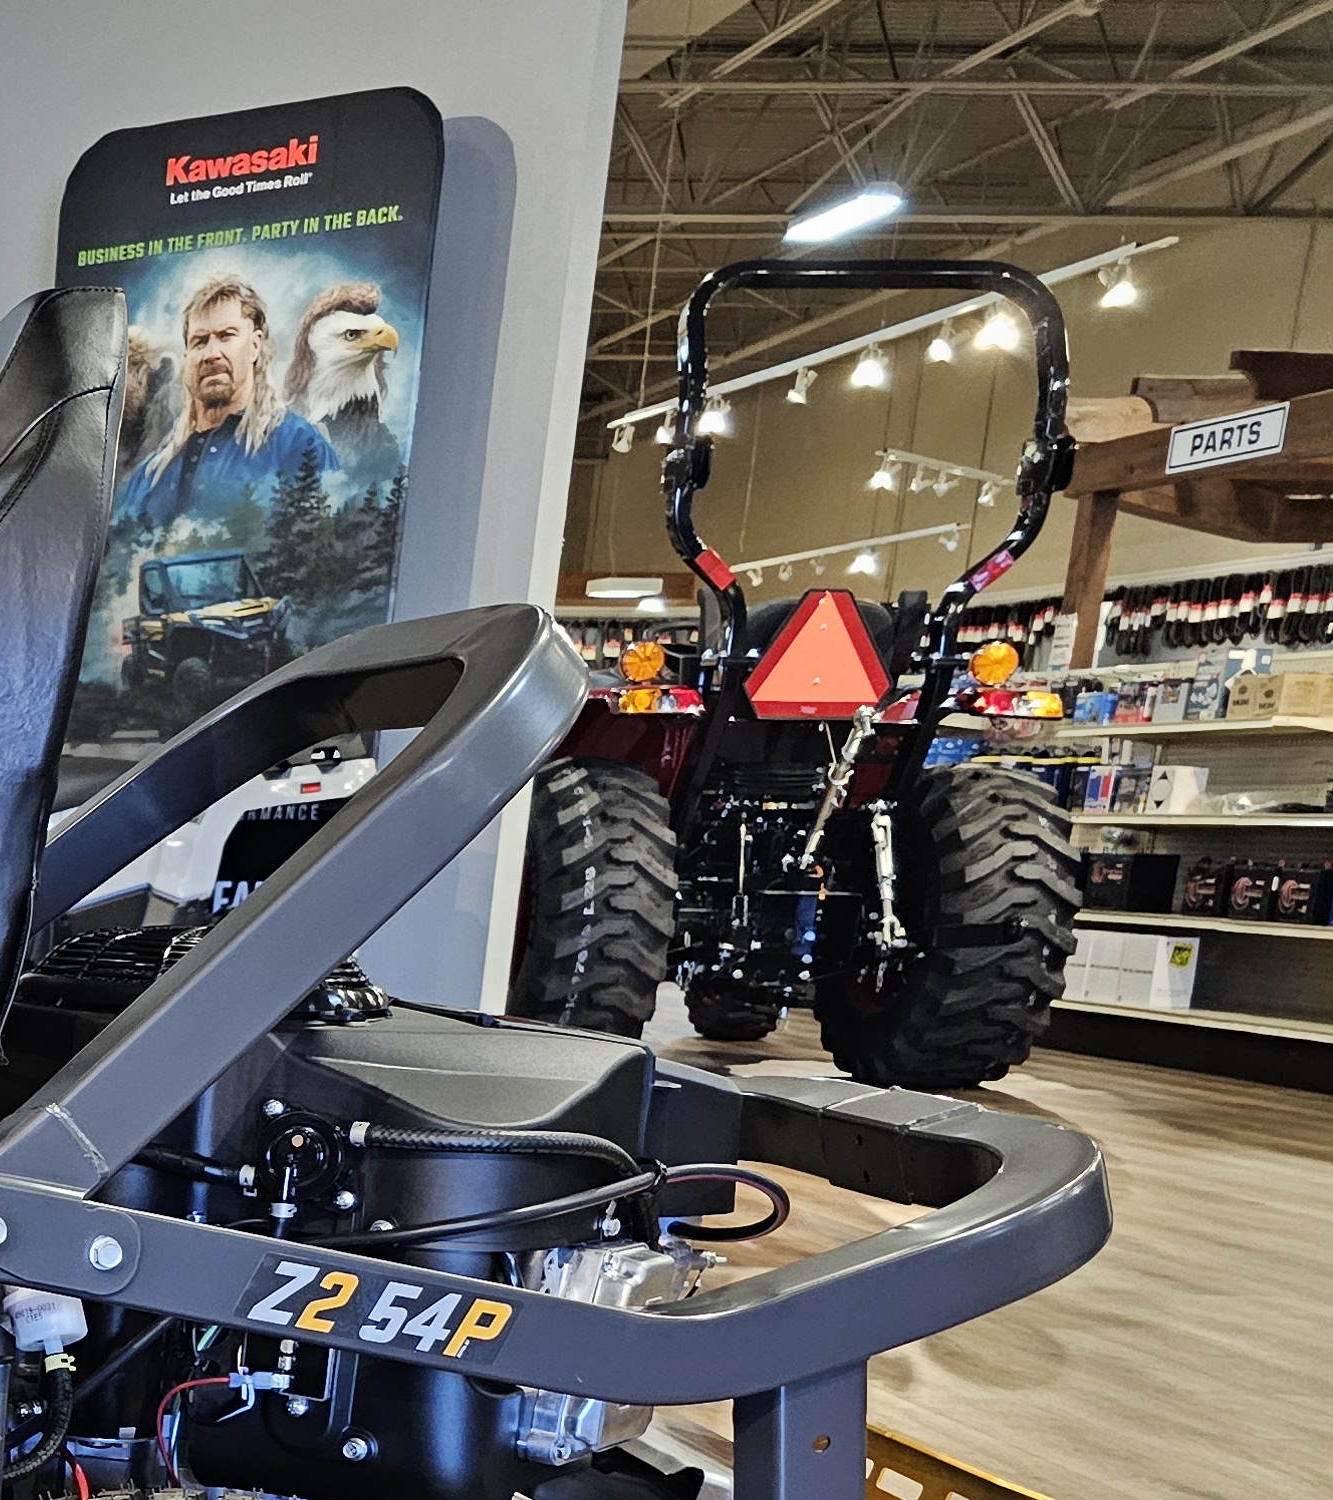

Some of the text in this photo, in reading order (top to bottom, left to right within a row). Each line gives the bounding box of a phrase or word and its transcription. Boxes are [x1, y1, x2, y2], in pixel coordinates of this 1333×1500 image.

[166, 135, 318, 186] Kawasaki
[170, 192, 189, 205] Let
[191, 189, 210, 201] the
[212, 182, 244, 198] Good
[246, 179, 282, 193] Times
[77, 205, 403, 267] BUSINESS IN THE FRONT. PARTY IN THE BACK.
[1190, 420, 1262, 457] PARTS
[247, 1261, 513, 1358] Z2 54P
